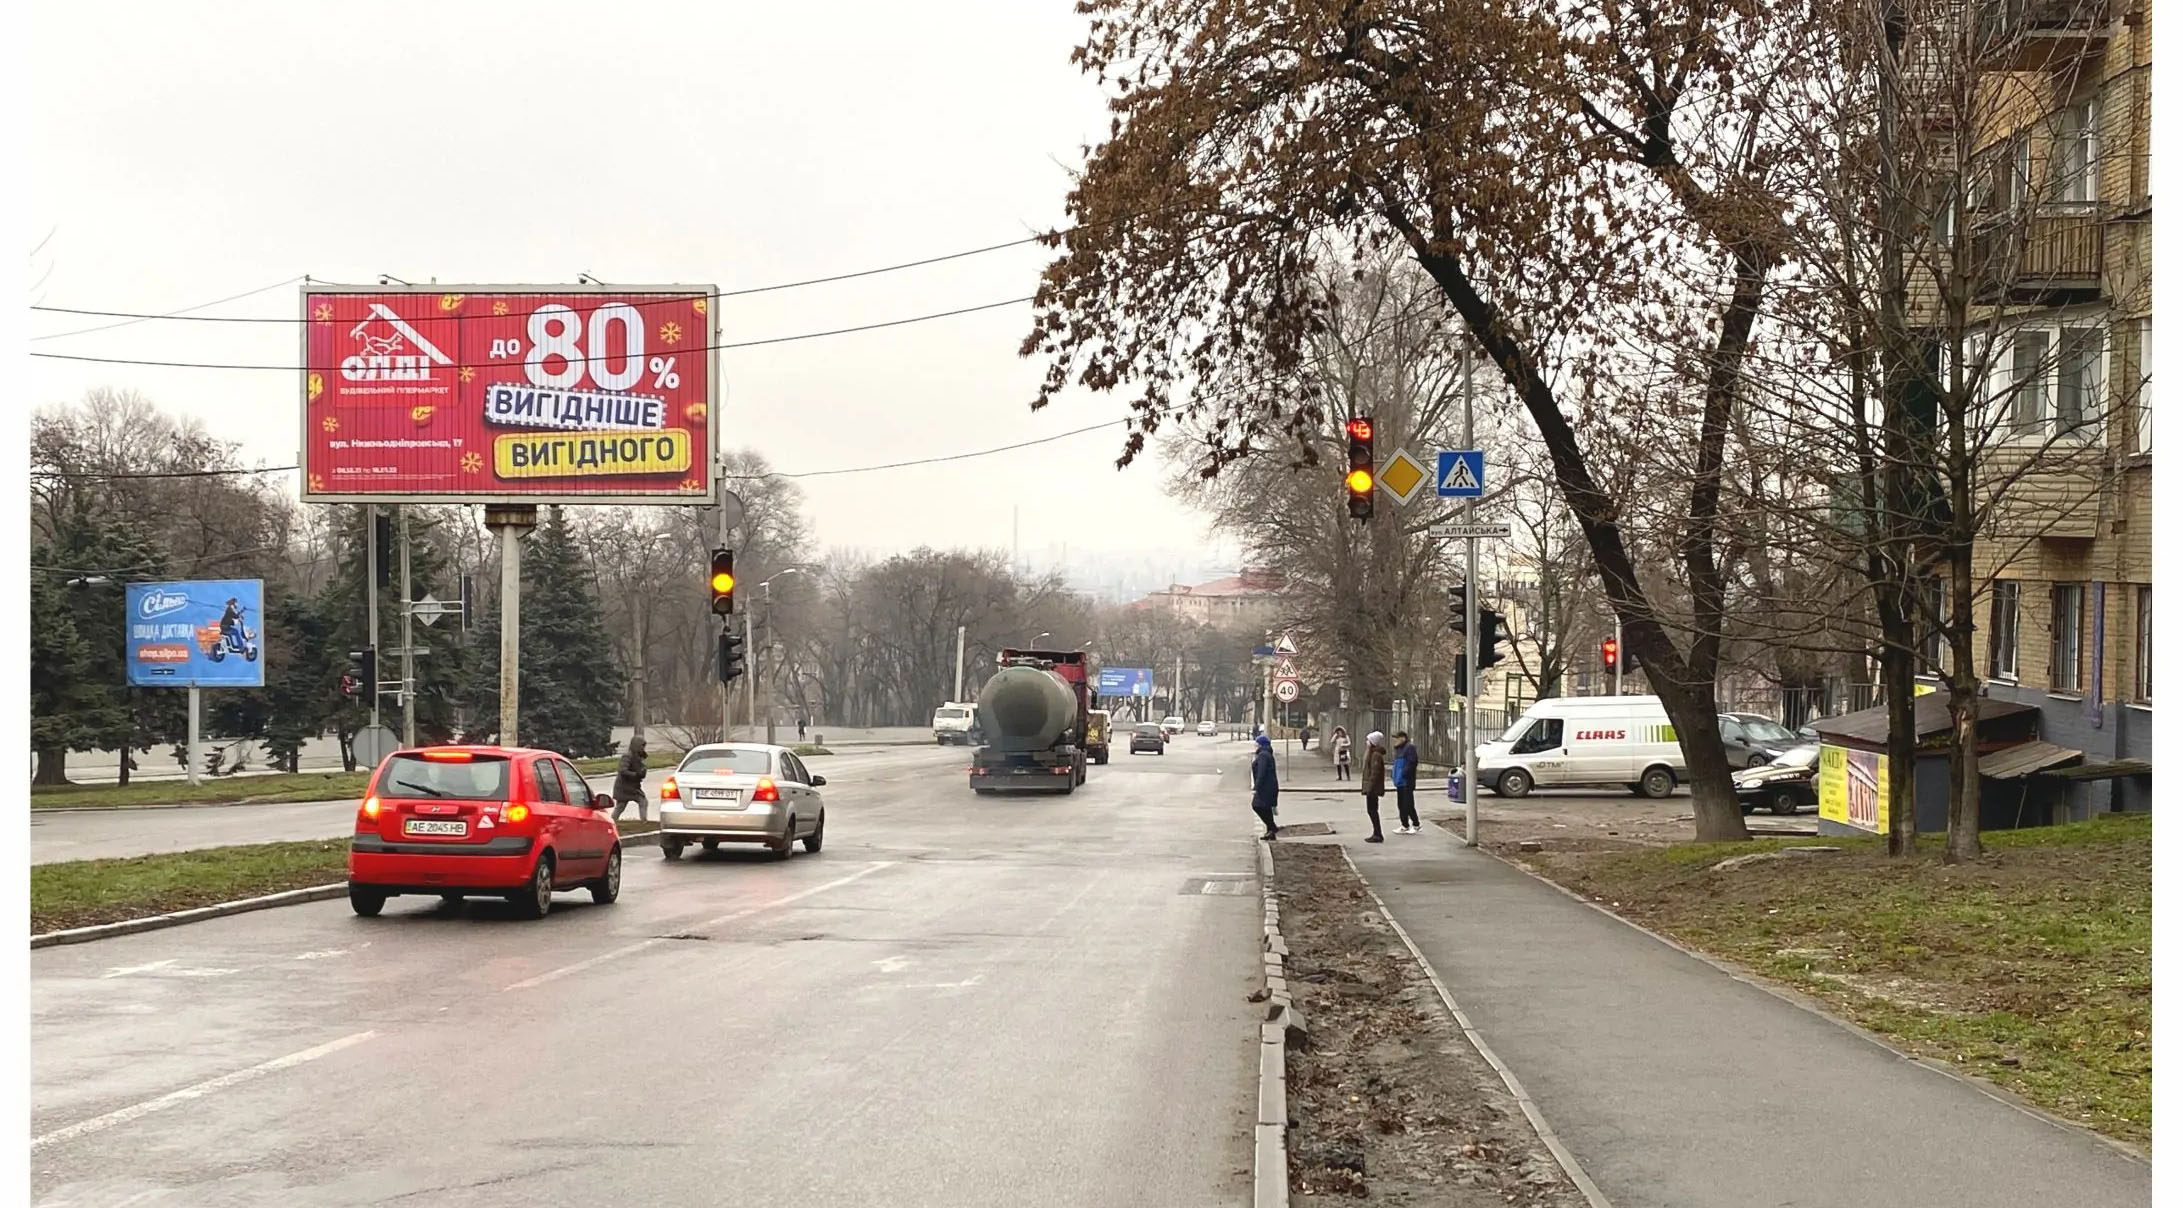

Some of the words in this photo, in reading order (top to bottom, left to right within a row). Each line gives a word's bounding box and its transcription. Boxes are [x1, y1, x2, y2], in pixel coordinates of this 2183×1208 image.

[489, 338, 521, 358] до
[494, 390, 659, 428] ВИГІДНІШЕ
[511, 437, 675, 468] ВИГІДНОГО
[1279, 685, 1294, 695] 40
[1576, 730, 1626, 740] CLAAS
[411, 822, 426, 832] AE
